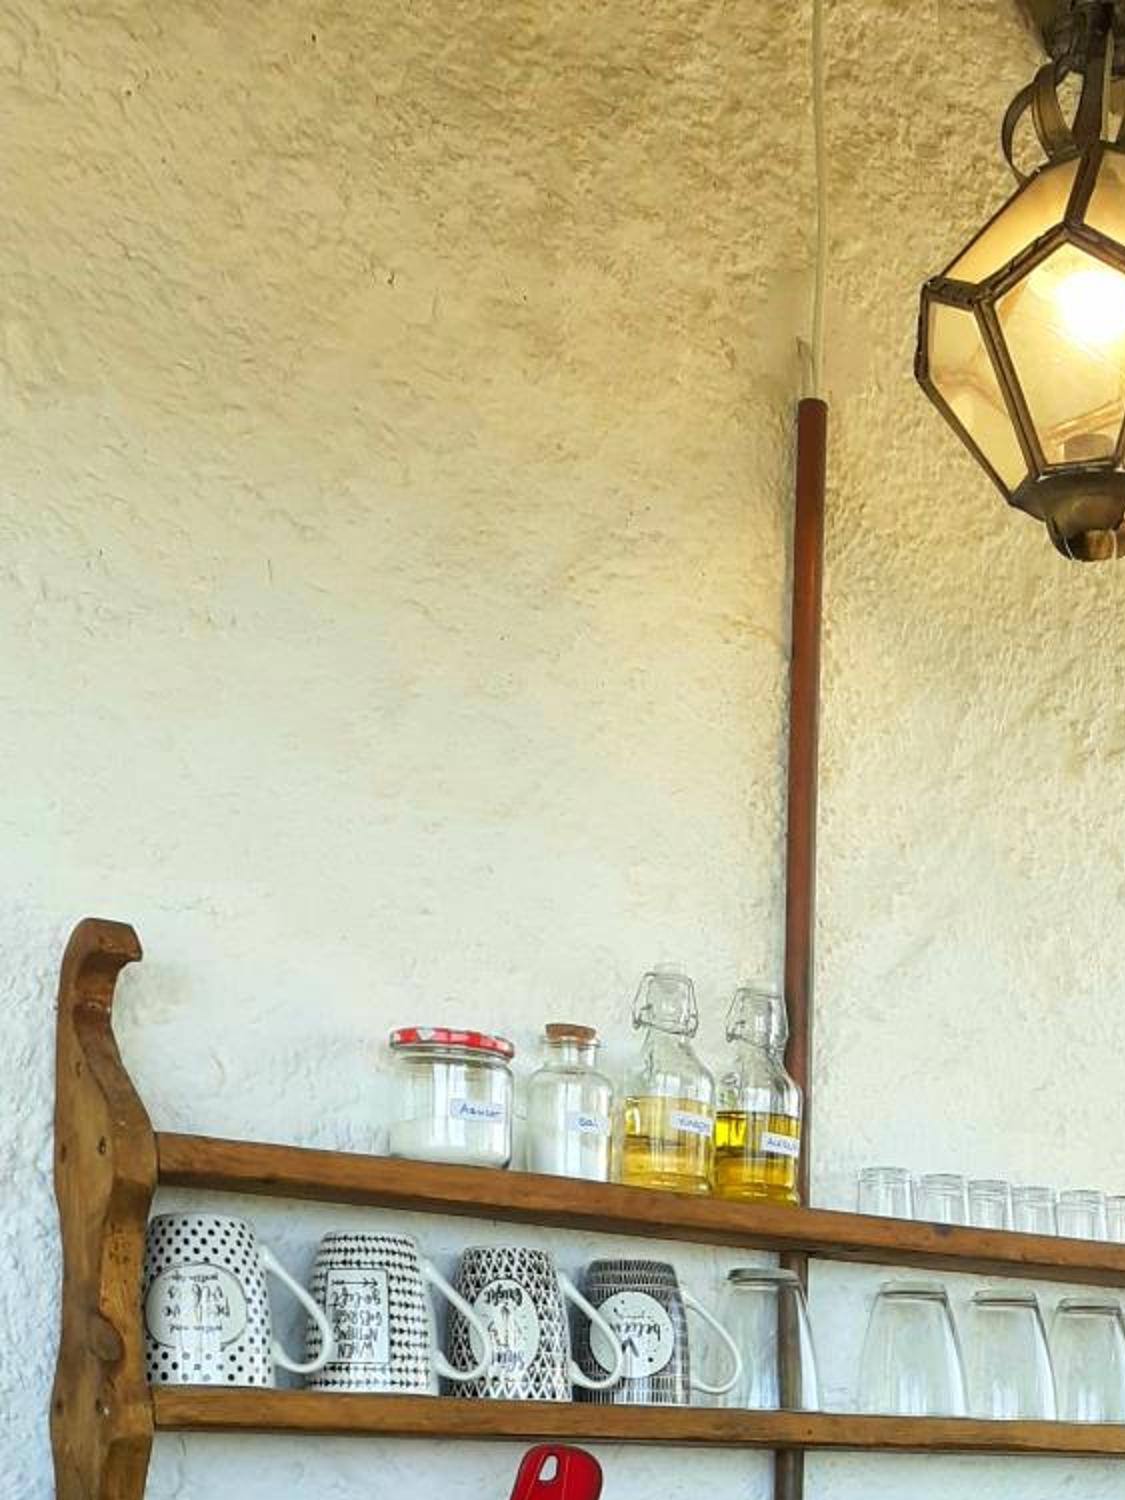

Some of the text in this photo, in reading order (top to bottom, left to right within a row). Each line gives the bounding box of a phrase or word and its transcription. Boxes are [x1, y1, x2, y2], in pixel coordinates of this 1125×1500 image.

[484, 1284, 524, 1308] bright
[609, 1322, 662, 1343] believ
[337, 1341, 375, 1359] WHEN
[491, 1349, 526, 1373] Shin
